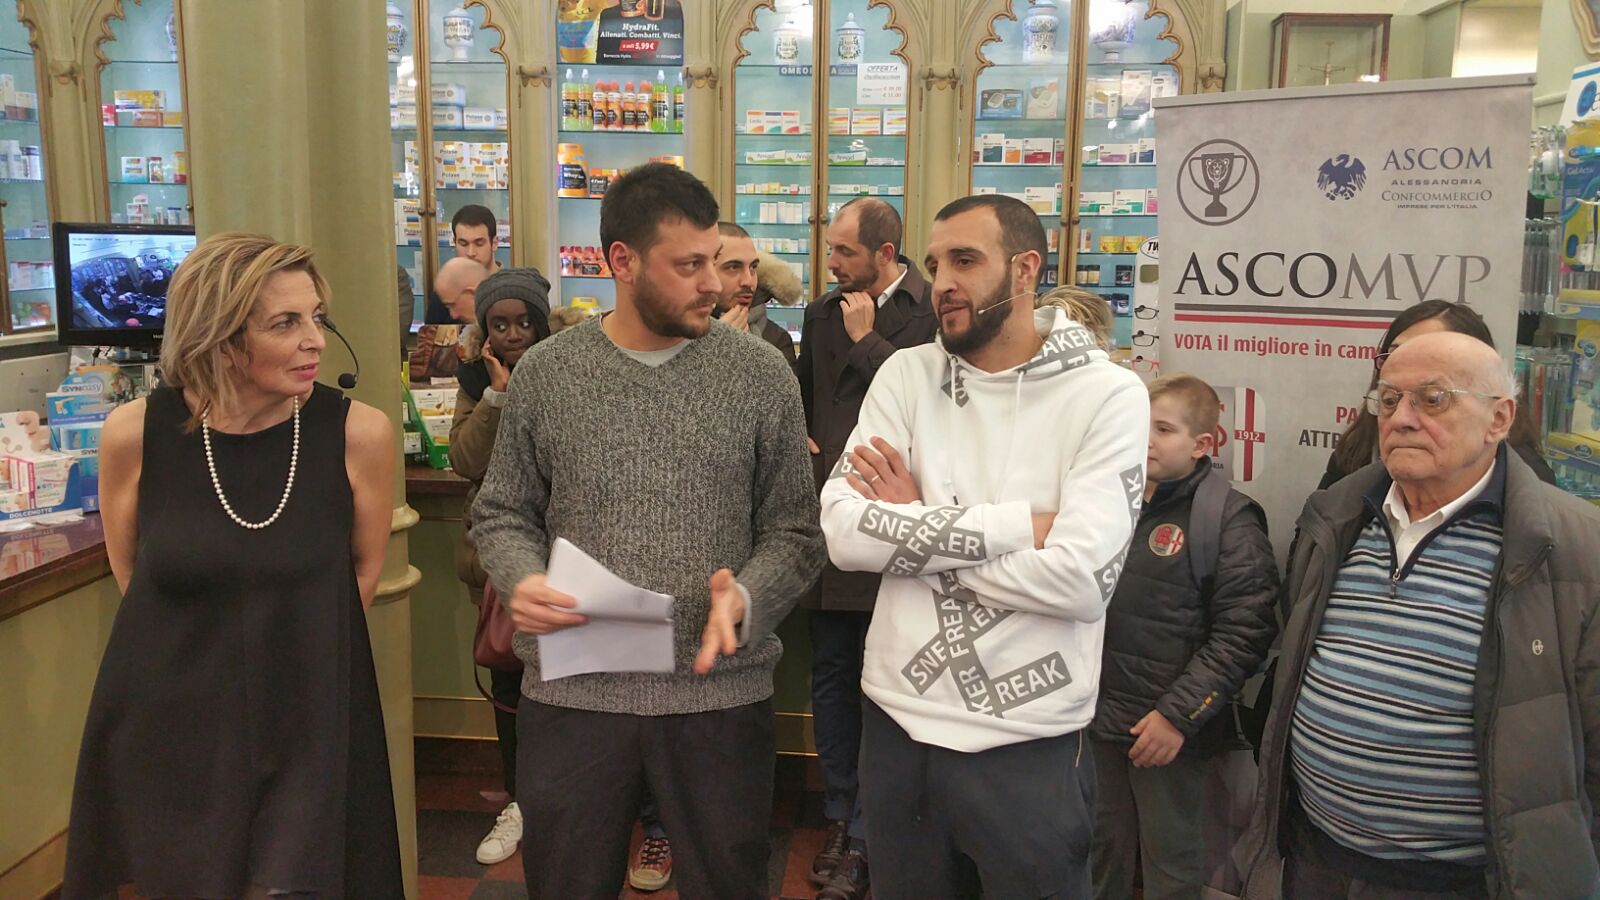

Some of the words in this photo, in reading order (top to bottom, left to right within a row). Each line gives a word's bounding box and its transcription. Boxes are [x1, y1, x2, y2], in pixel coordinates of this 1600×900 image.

[621, 23, 660, 32] HydraFit.
[1381, 146, 1493, 171] ASCOM
[1173, 251, 1491, 304] ASCOMVP
[1174, 334, 1212, 351] VOTA
[1217, 334, 1228, 351] il
[1234, 335, 1309, 356] migliore
[1315, 339, 1332, 357] in
[1337, 344, 1375, 360] cam
[1336, 406, 1361, 425] PA
[1238, 430, 1260, 441] 1912
[994, 658, 1066, 705] REAK
